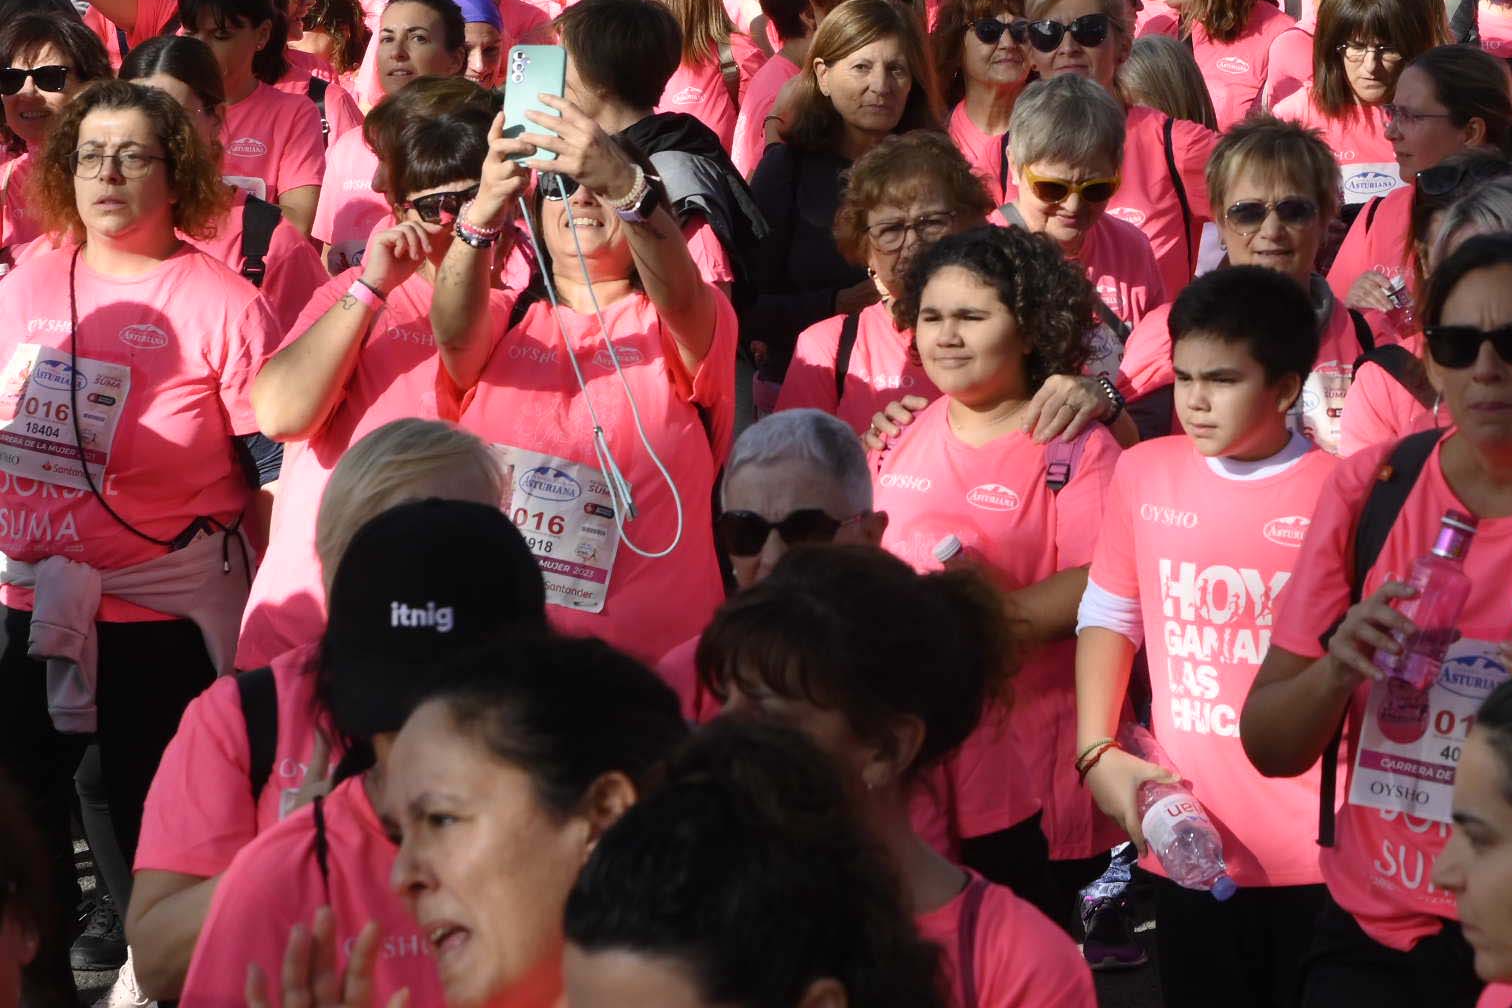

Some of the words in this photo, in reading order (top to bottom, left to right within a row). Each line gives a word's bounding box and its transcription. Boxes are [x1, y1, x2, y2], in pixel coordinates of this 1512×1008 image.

[1349, 179, 1392, 189] ASTURIANA
[25, 421, 60, 439] 18404
[880, 473, 931, 491] OYSHO
[0, 506, 80, 542] SUMA
[1140, 503, 1198, 529] OYSHO
[539, 559, 571, 573] MUJER
[1159, 558, 1292, 626] HOY
[390, 601, 454, 632] itnig
[1167, 657, 1220, 700] LAS
[1170, 697, 1241, 738] CHIC
[1433, 709, 1474, 738] 01
[1440, 744, 1462, 763] 40
[1380, 758, 1434, 779] CARRERA
[1436, 769, 1453, 782] DE
[1370, 780, 1430, 806] OYSHO
[1375, 838, 1436, 891] SU
